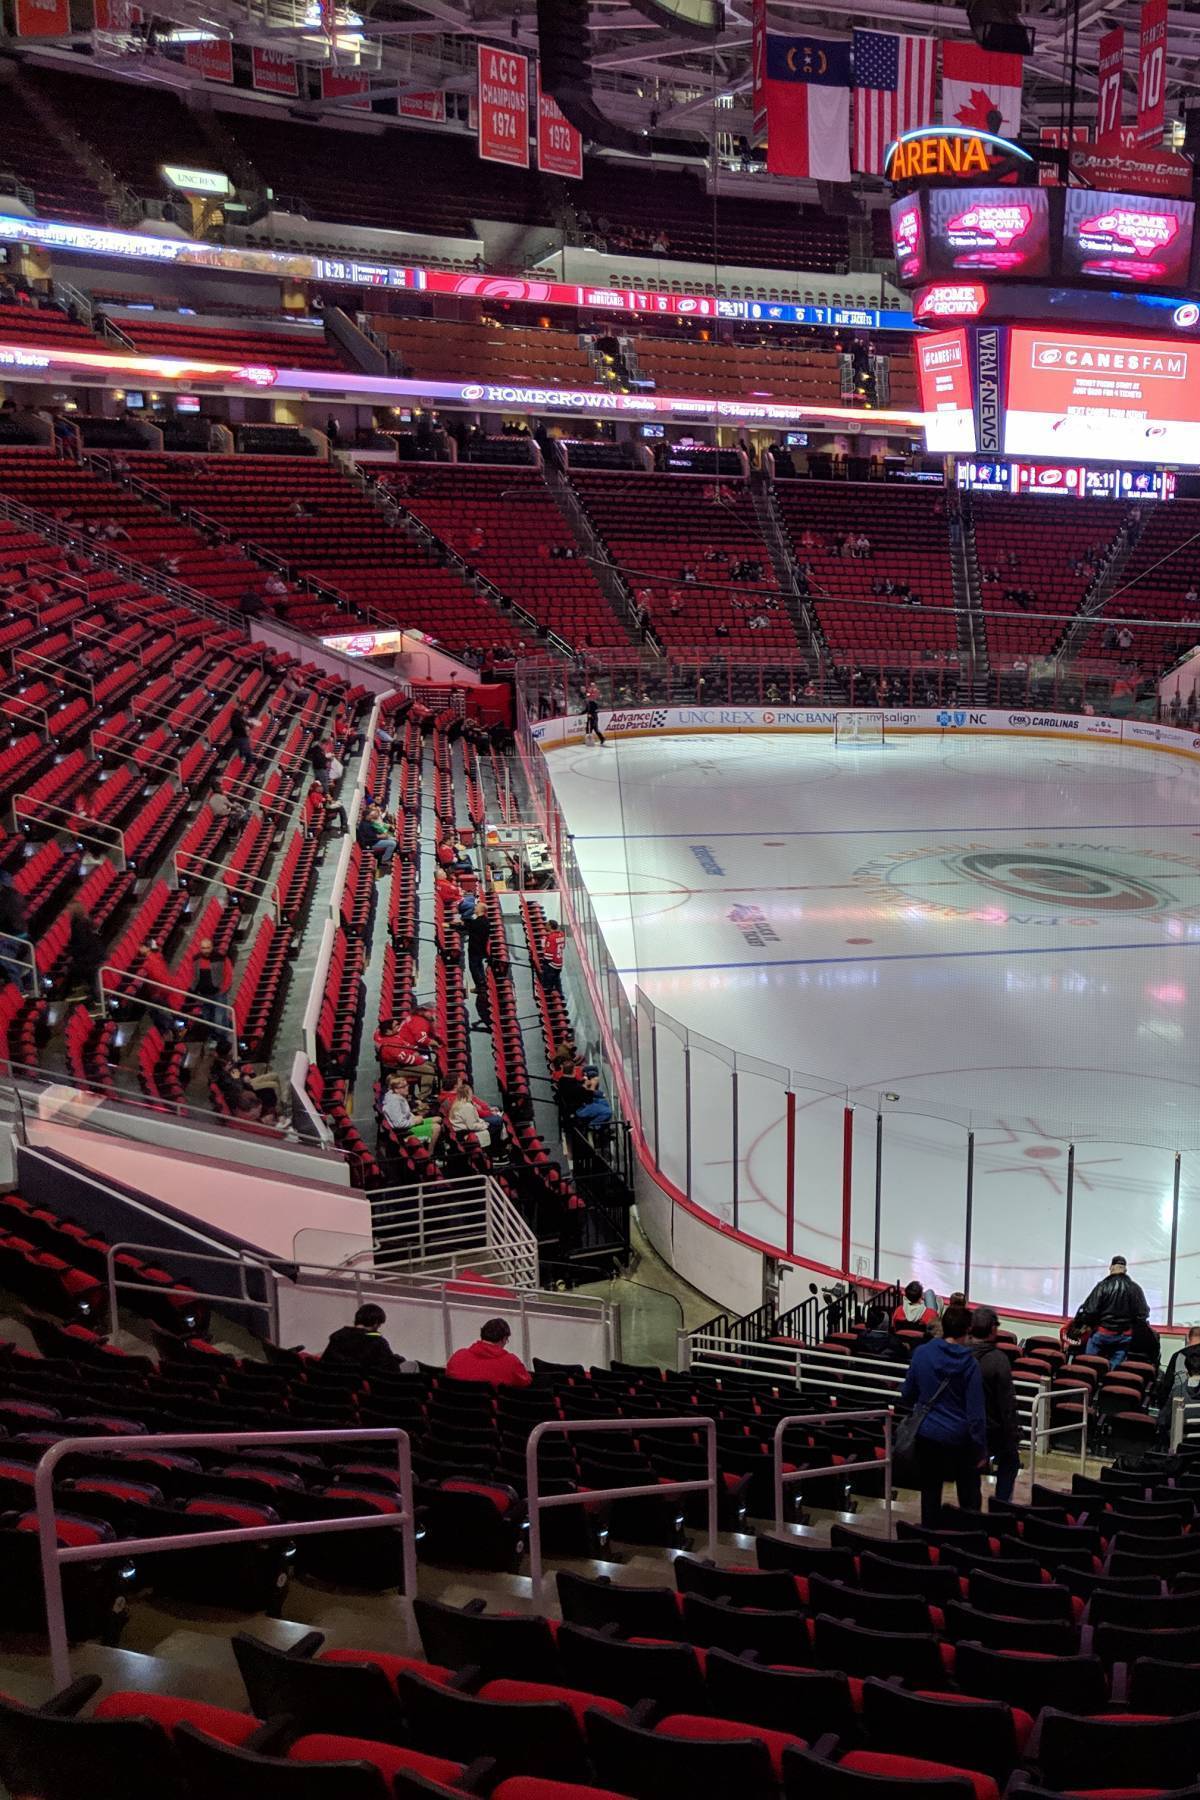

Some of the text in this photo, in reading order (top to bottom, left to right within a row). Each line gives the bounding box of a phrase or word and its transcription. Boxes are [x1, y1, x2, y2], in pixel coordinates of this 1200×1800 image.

[489, 54, 518, 85] ACC
[1141, 46, 1163, 112] 10
[482, 83, 526, 111] CHAMPIONS
[1100, 71, 1120, 134] 17
[492, 112, 516, 139] 1974
[549, 126, 571, 152] 1973
[890, 136, 990, 181] ARENA
[1155, 164, 1191, 176] GAME
[177, 173, 196, 185] UNC
[979, 208, 1021, 220] HOME
[1118, 213, 1168, 229] HOME
[979, 219, 1024, 229] GROWN
[1117, 225, 1170, 239] GROWN
[587, 293, 625, 307] HURRICANES
[934, 286, 975, 301] HOME
[934, 300, 978, 313] GROWN
[834, 313, 850, 324] BLUE
[850, 314, 873, 326] JACKETS
[1065, 350, 1181, 373] CANESFAM
[979, 331, 997, 449] WRAL NEWS
[487, 386, 618, 408] HOMEGROWN
[671, 402, 706, 412] PRESENTED
[730, 403, 766, 418] Harris
[766, 406, 802, 420] Teeter
[609, 711, 651, 723] Advance
[679, 711, 755, 724] UNC REX
[777, 712, 838, 724] PNC BANK
[866, 712, 917, 725] invisalign
[969, 713, 988, 726] NC
[1031, 716, 1080, 729] CAROLINAS
[605, 721, 650, 731] Auto Parts
